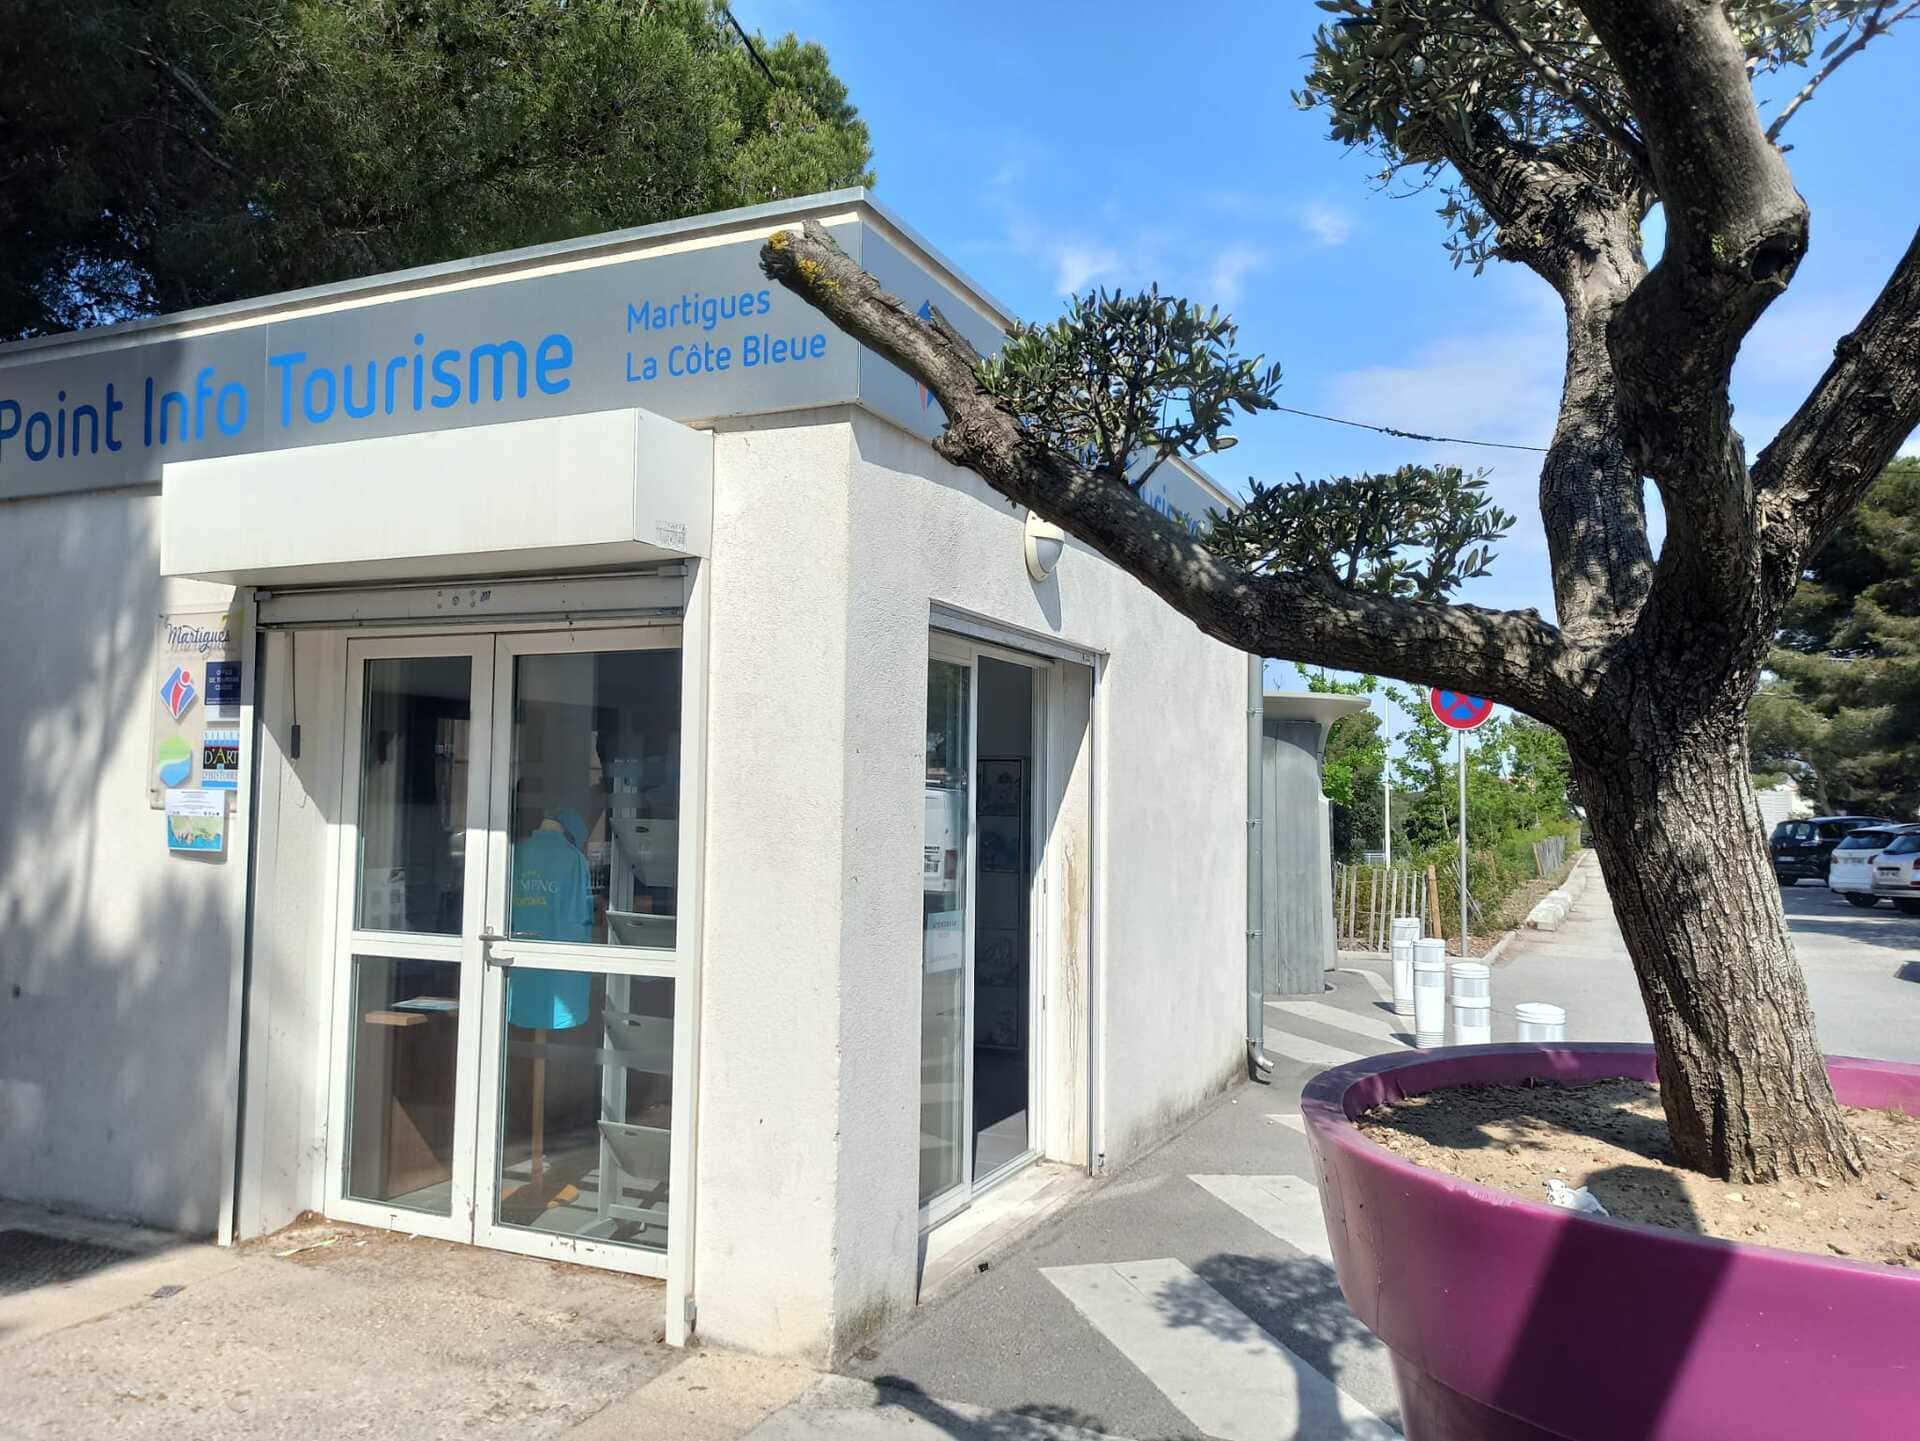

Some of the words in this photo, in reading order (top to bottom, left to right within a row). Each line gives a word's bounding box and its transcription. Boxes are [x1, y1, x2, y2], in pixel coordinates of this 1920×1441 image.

[626, 289, 771, 334] Martigues
[626, 352, 657, 382] La
[668, 341, 732, 376] Côte
[743, 333, 827, 367] Bleue
[0, 383, 124, 463] Point
[143, 366, 250, 448] Info
[267, 332, 574, 428] Tourisme
[167, 623, 231, 653] Martigues
